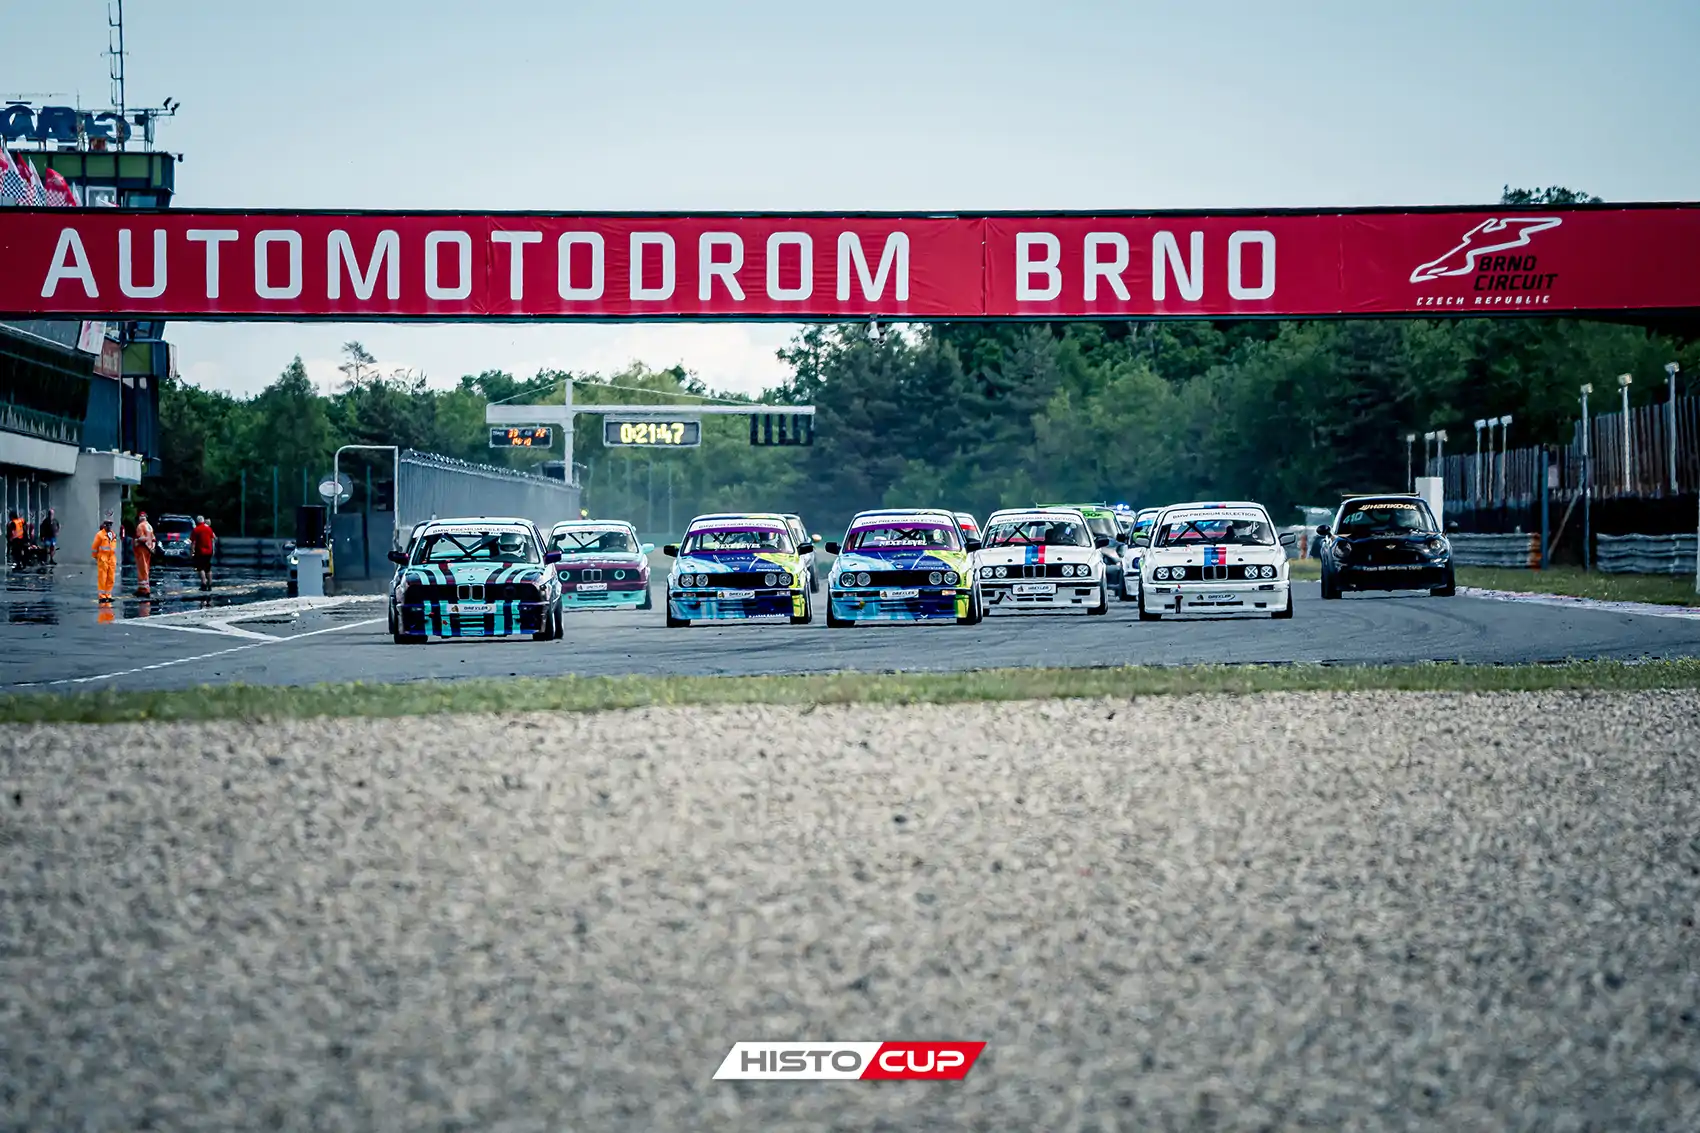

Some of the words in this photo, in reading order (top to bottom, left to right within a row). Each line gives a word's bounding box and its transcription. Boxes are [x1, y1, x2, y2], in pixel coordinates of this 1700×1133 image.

[41, 228, 909, 301] AUTOMOTODROM
[1015, 230, 1277, 302] BRNO
[1478, 255, 1538, 272] BRNO
[1473, 273, 1559, 291] CIRCUIT
[1416, 296, 1465, 306] CZECH
[1474, 295, 1551, 305] REPUBLIC
[1343, 511, 1364, 524] 410
